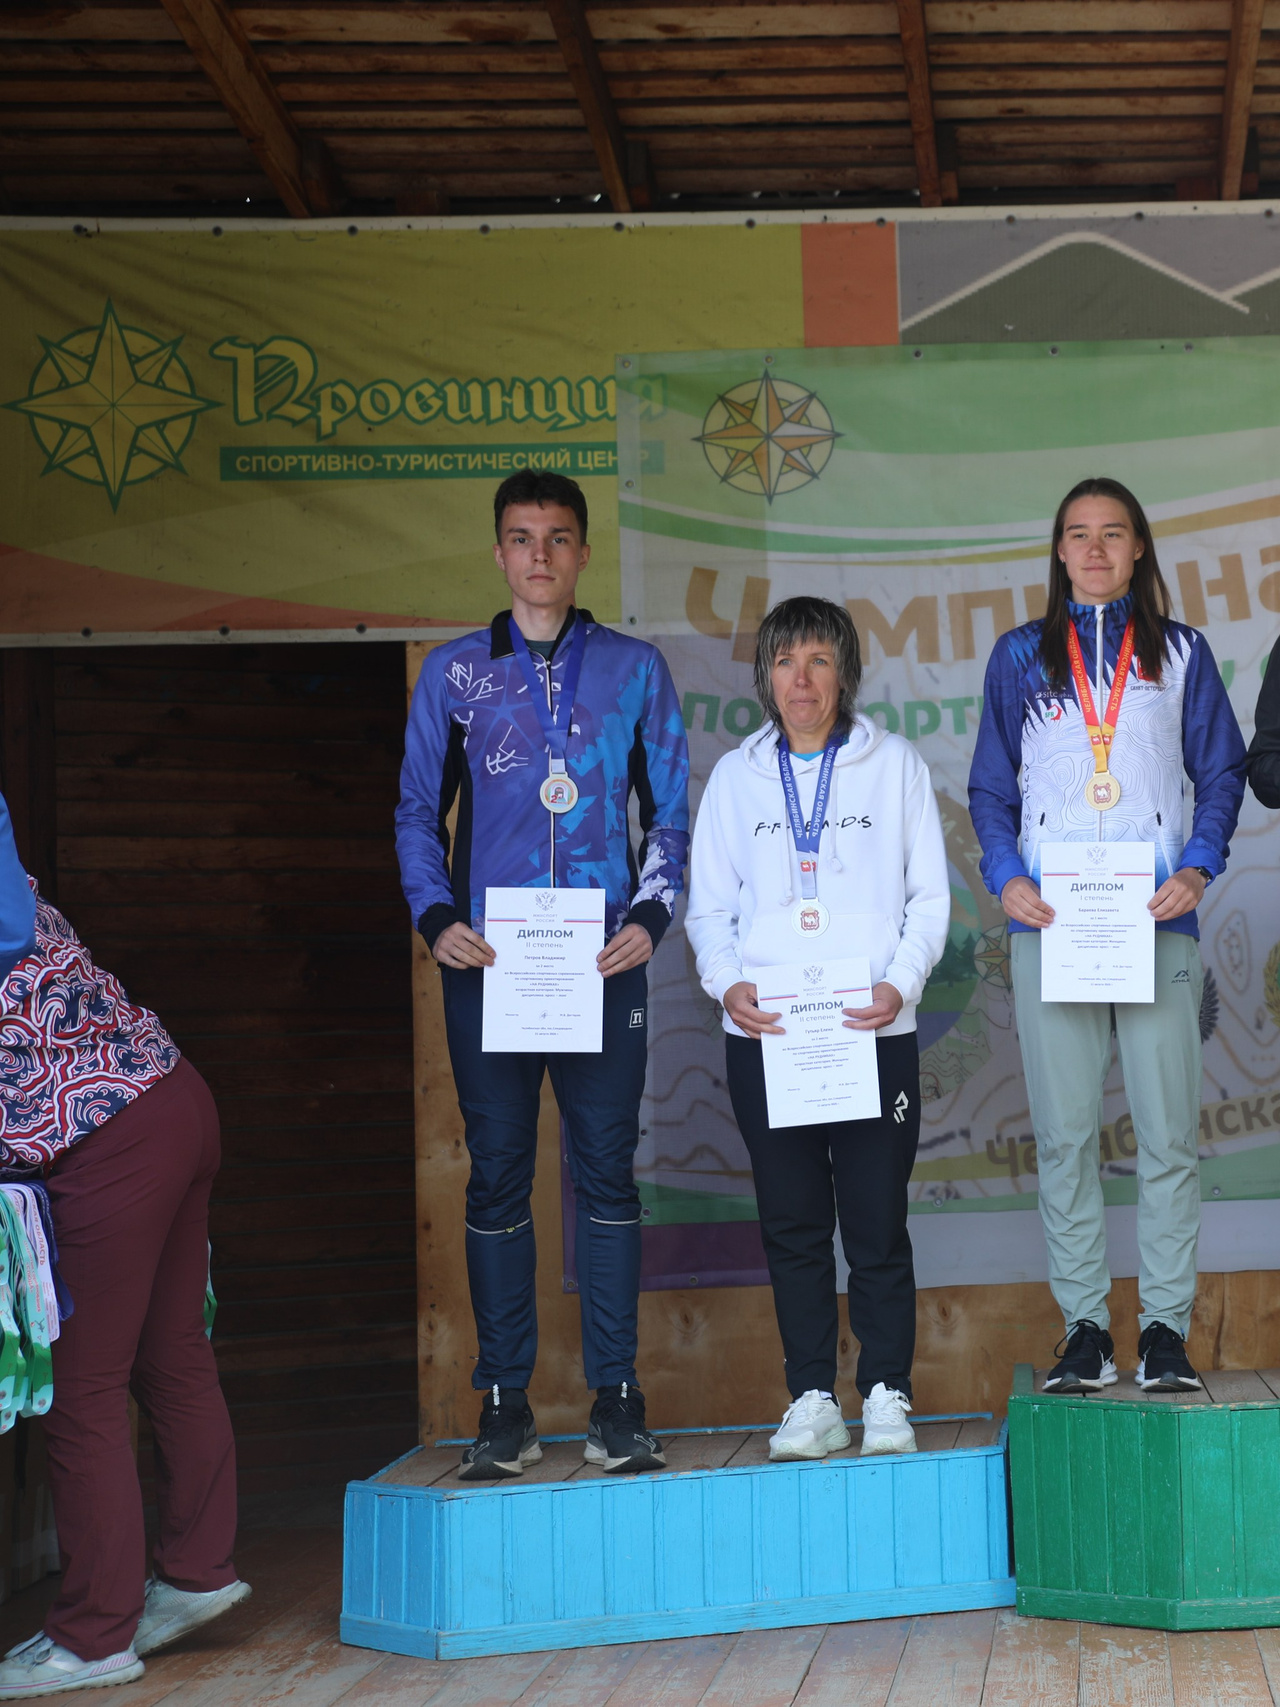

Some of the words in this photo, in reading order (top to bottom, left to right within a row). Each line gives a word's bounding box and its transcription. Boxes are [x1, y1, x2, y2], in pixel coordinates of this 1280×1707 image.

[235, 447, 572, 474] СПОРТИВНО-ТУРИСТИЧЕСКИЙ
[780, 750, 791, 782] ОБЛАСТЬ
[817, 746, 836, 801] ЧЕЛЯБИНСКАЯ
[785, 783, 803, 839] ЧЕЛЯБИНСКАЯ
[811, 801, 824, 837] ОБЛАСТЬ
[1070, 883, 1124, 892] ДИПЛОМ
[517, 929, 573, 939] ДИПЛОМ
[790, 1000, 844, 1014] ДИПЛОМ
